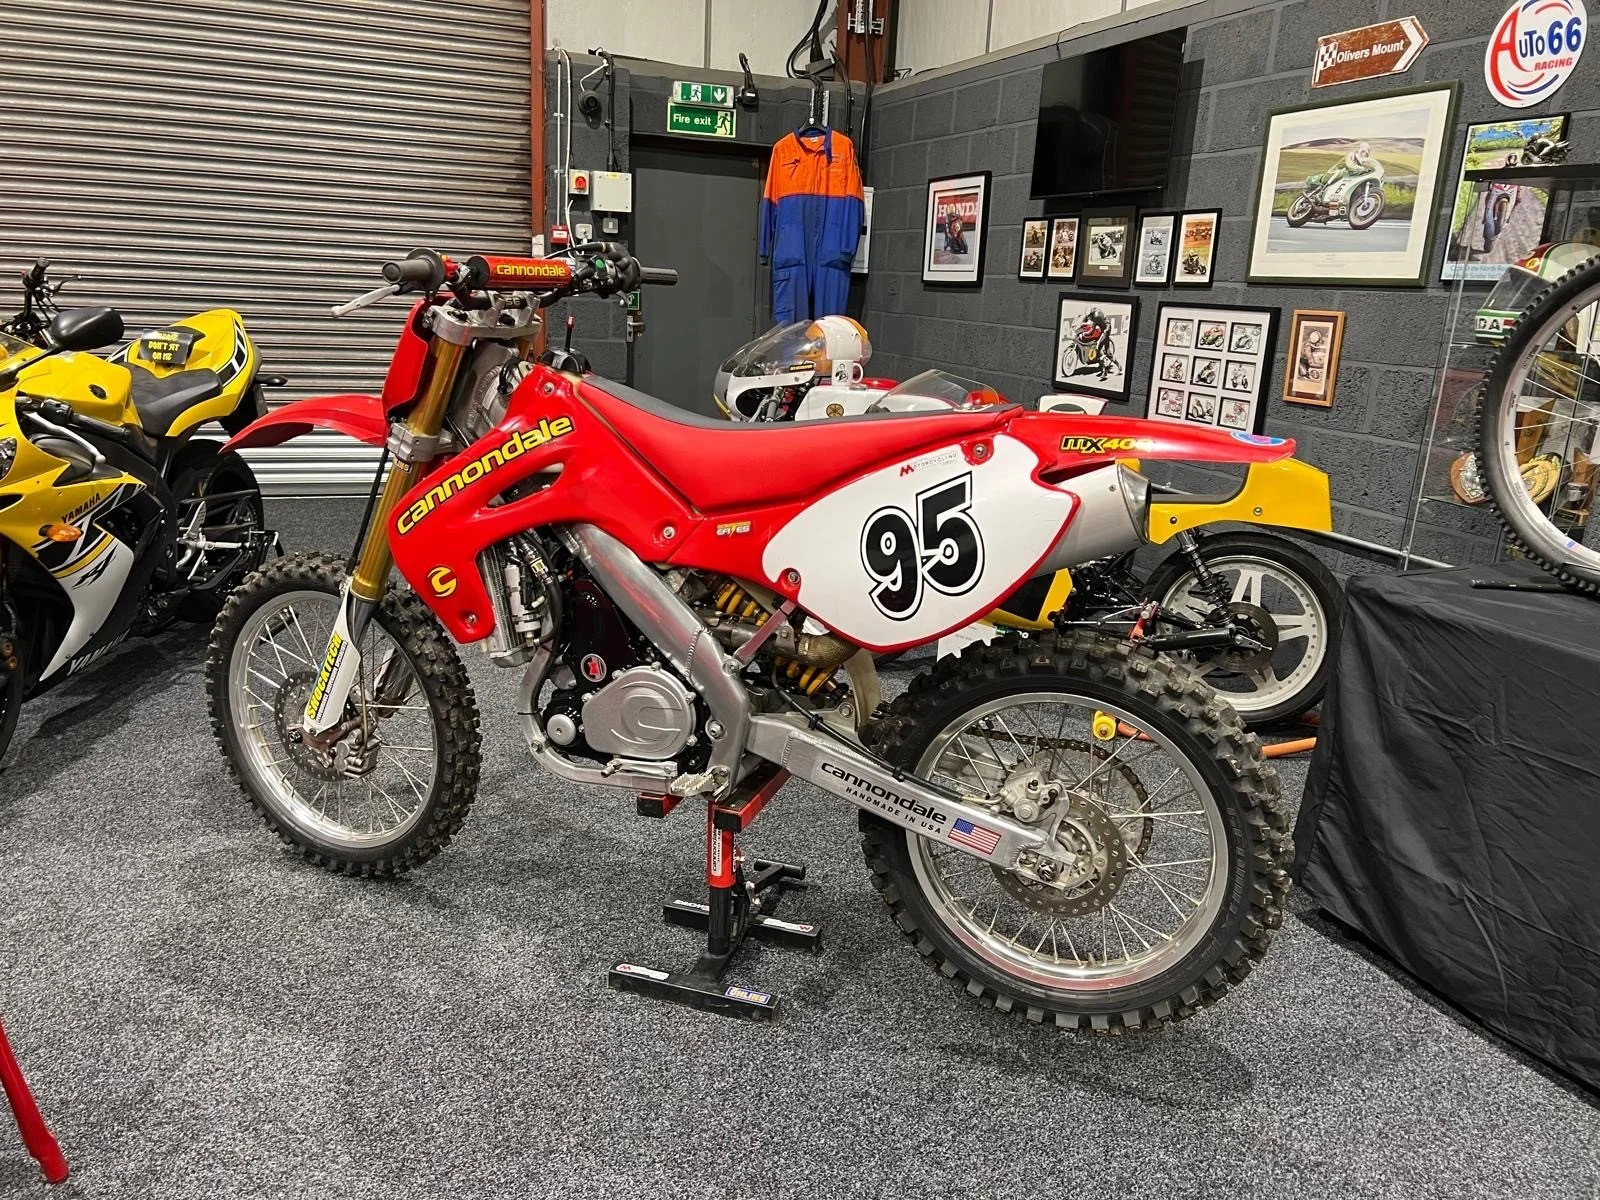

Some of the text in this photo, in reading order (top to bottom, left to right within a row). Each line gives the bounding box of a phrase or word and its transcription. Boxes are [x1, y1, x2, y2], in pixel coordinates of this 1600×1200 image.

[1336, 40, 1404, 63] Olivers Mount
[1547, 17, 1582, 55] 66
[1534, 57, 1573, 71] RACING
[673, 113, 711, 126] Fire exit
[938, 202, 978, 217] HOND
[496, 264, 566, 277] cannondale
[397, 416, 573, 535] cannondale
[62, 492, 101, 523] YAMAHA
[860, 471, 985, 621] 95
[307, 631, 343, 720] SHOCKTECH
[821, 762, 947, 824] cannondale
[846, 786, 942, 835] HANDMADE IN USA
